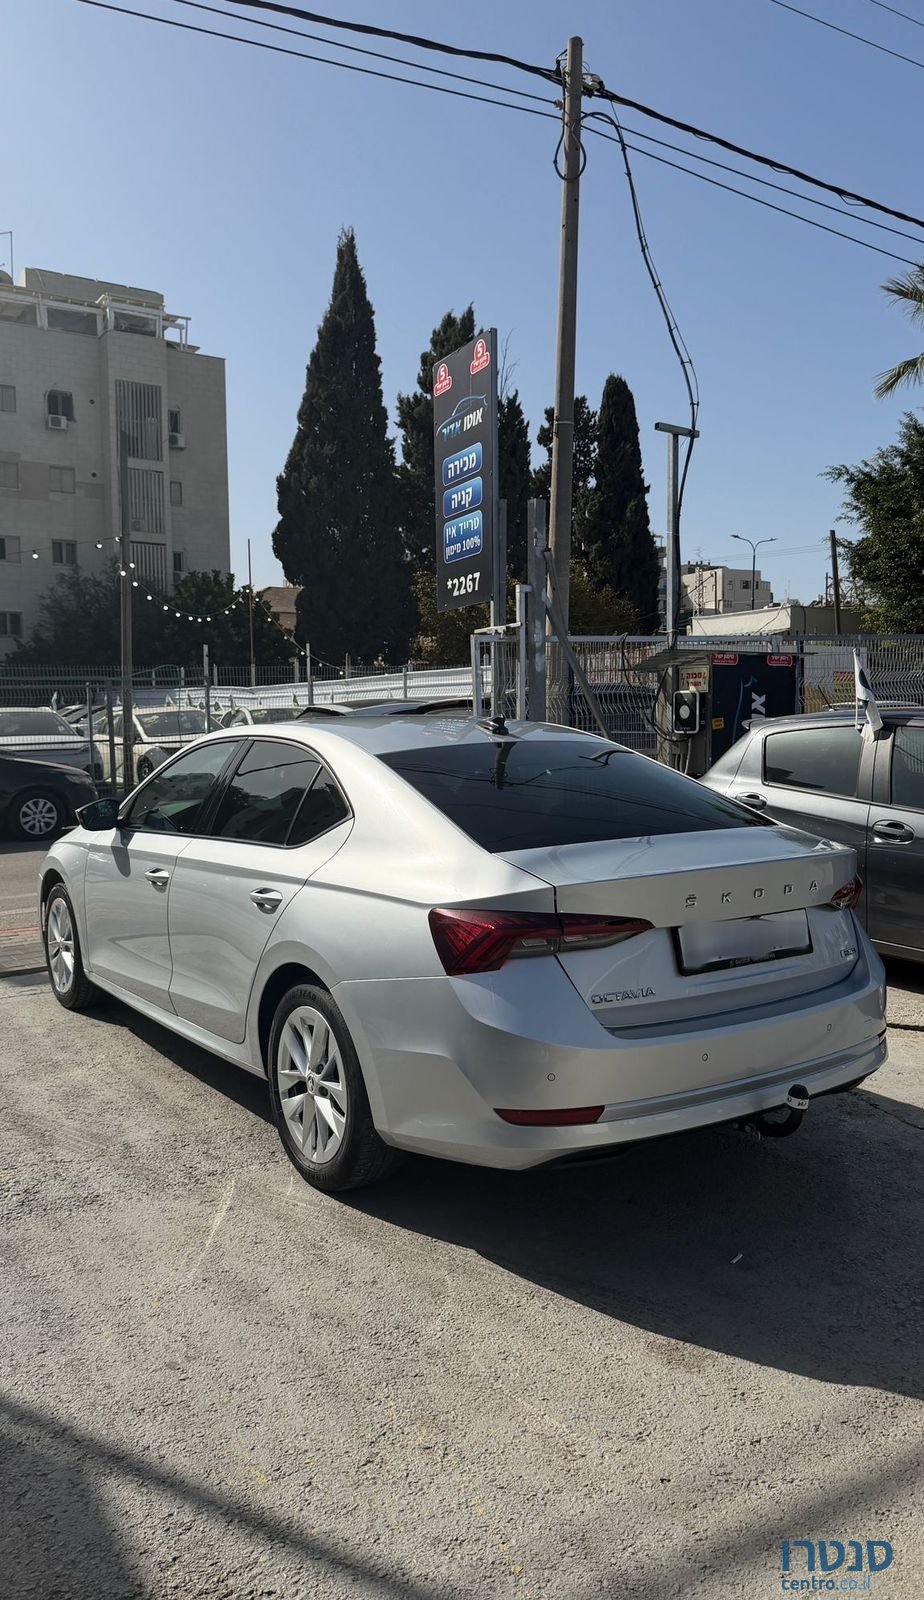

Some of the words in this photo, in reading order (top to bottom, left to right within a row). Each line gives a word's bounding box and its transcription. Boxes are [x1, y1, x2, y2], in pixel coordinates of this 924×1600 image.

[463, 407, 483, 432] אוטו
[448, 452, 477, 479] מכירה
[451, 486, 473, 509] קניה
[446, 526, 457, 544] אין
[459, 517, 480, 535] טרייד
[445, 542, 461, 560] מימון
[462, 535, 480, 552] 100%
[591, 986, 656, 1005] OCTAVIA
